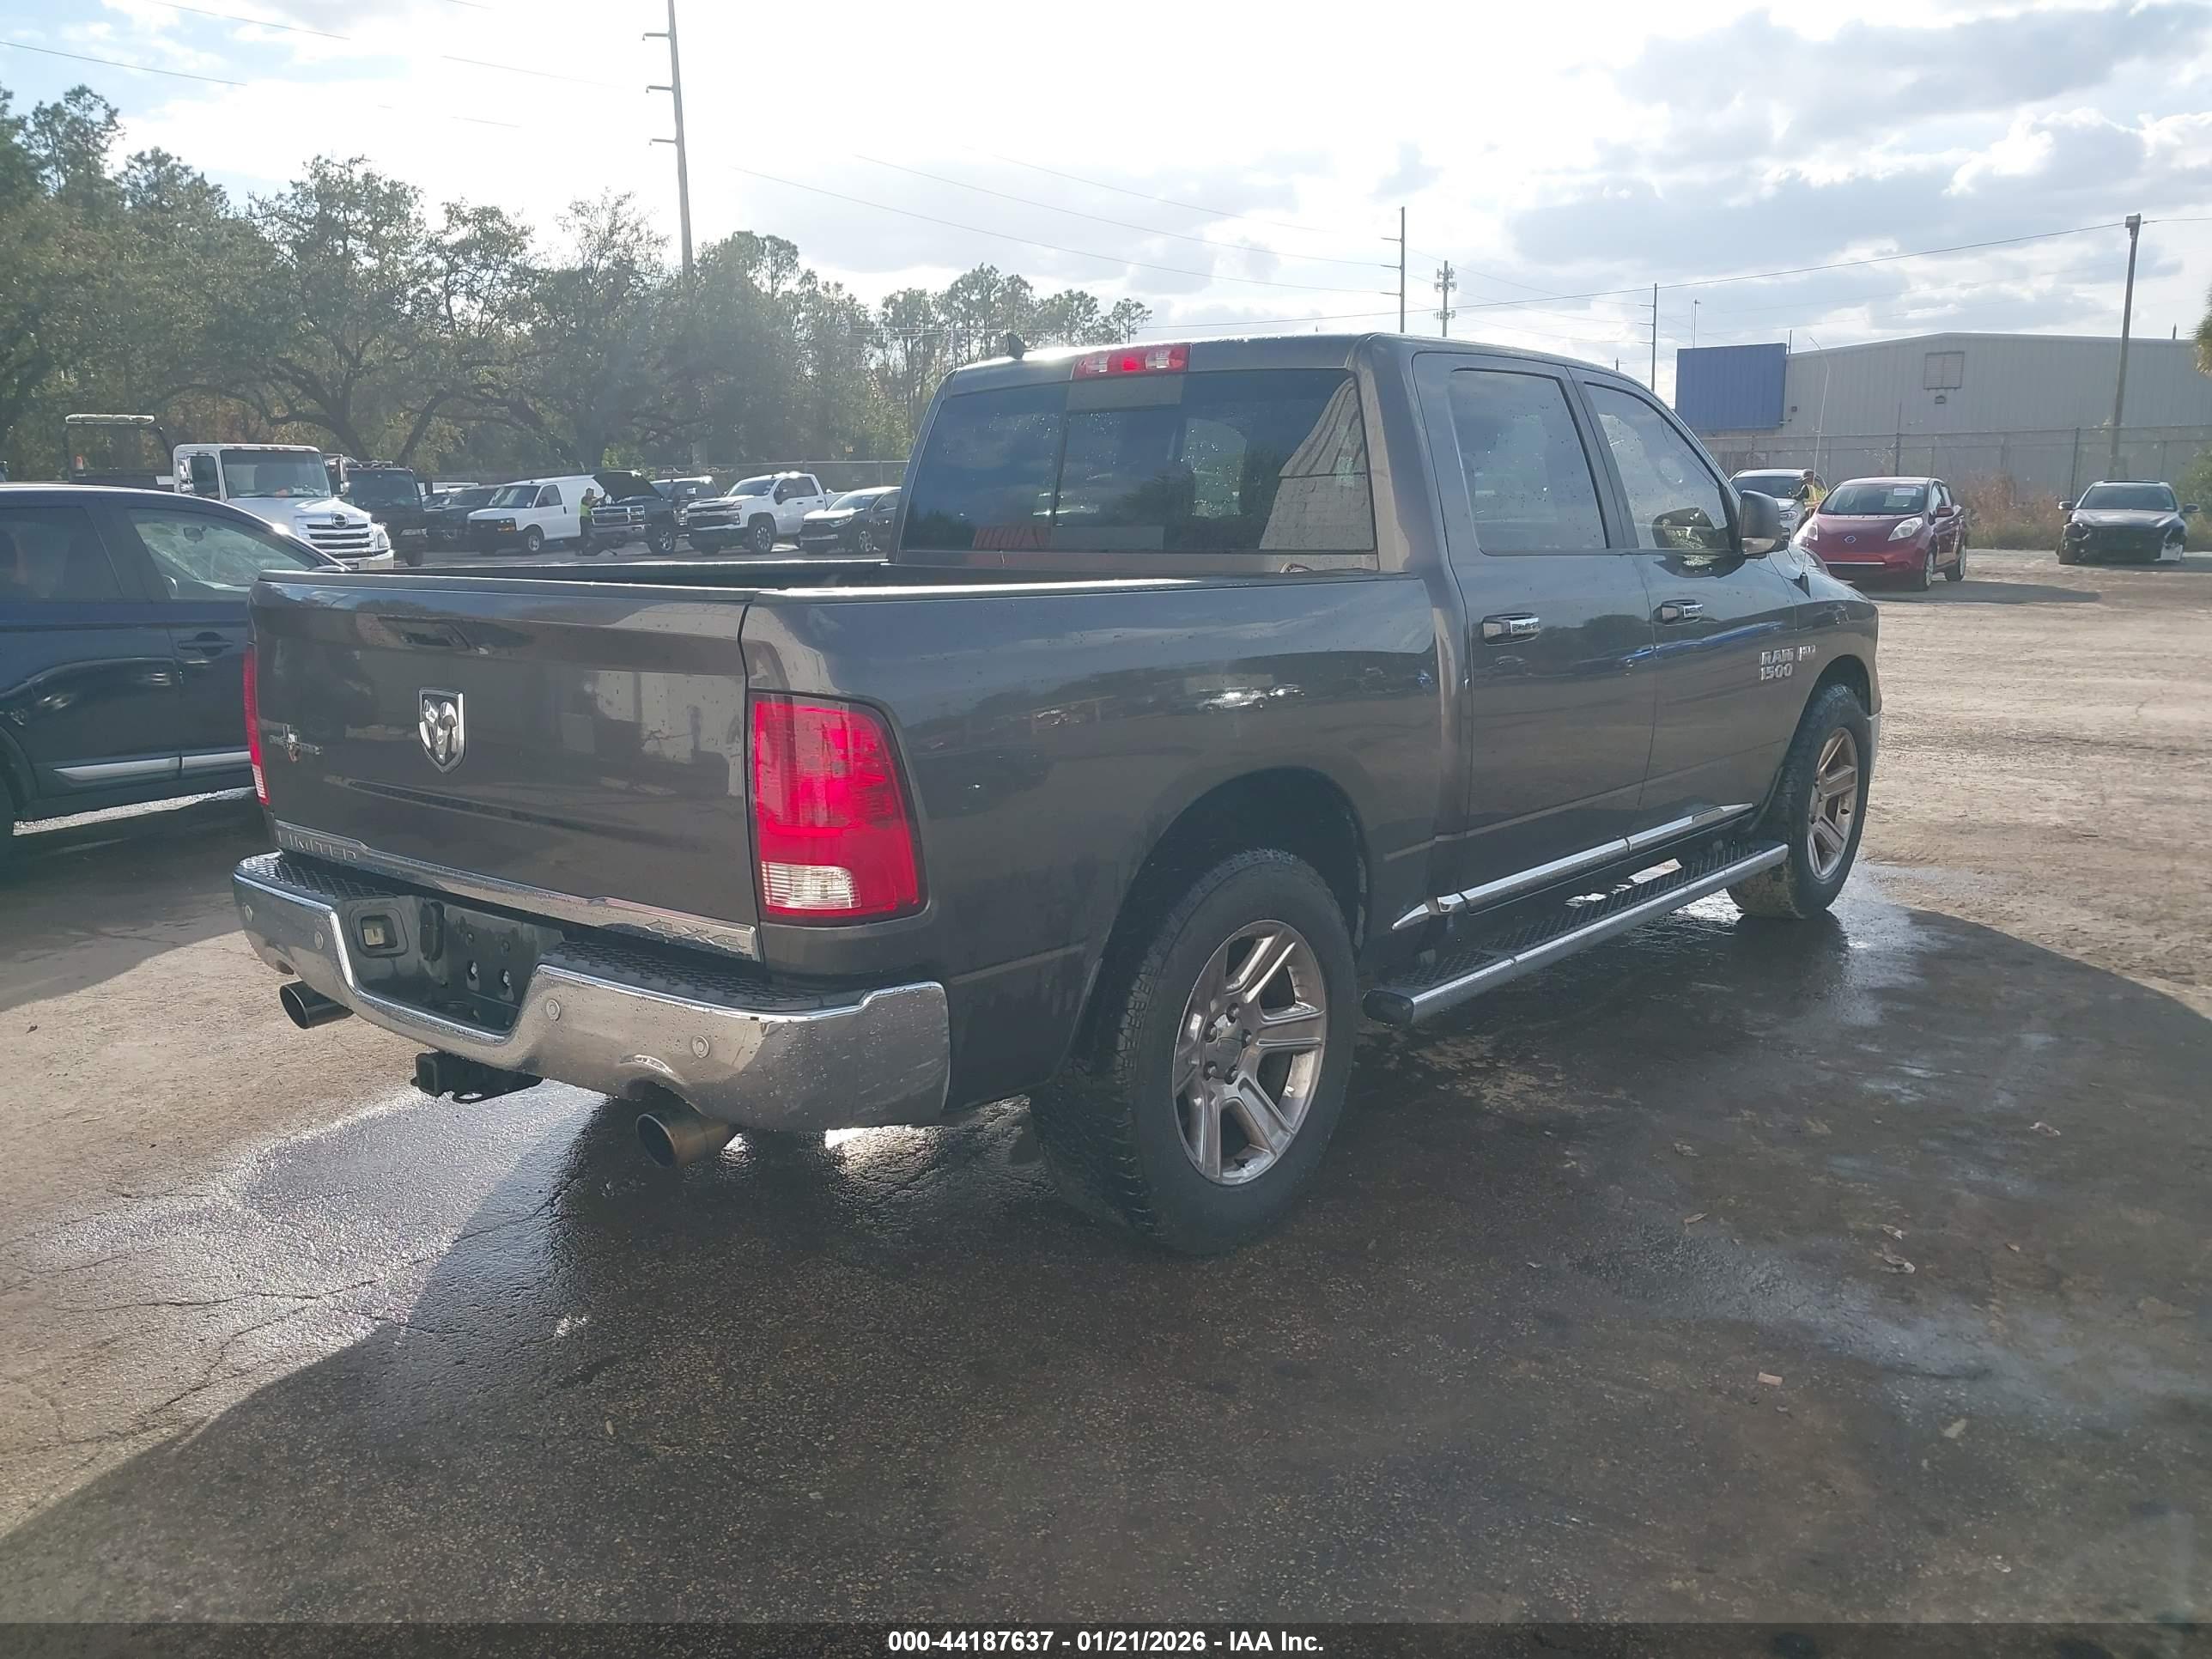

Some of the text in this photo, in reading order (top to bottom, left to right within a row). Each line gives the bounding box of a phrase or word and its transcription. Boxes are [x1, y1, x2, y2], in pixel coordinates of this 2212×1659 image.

[1760, 647, 1794, 665] RAM
[1760, 663, 1793, 681] 1500
[276, 830, 358, 862] LIMITED
